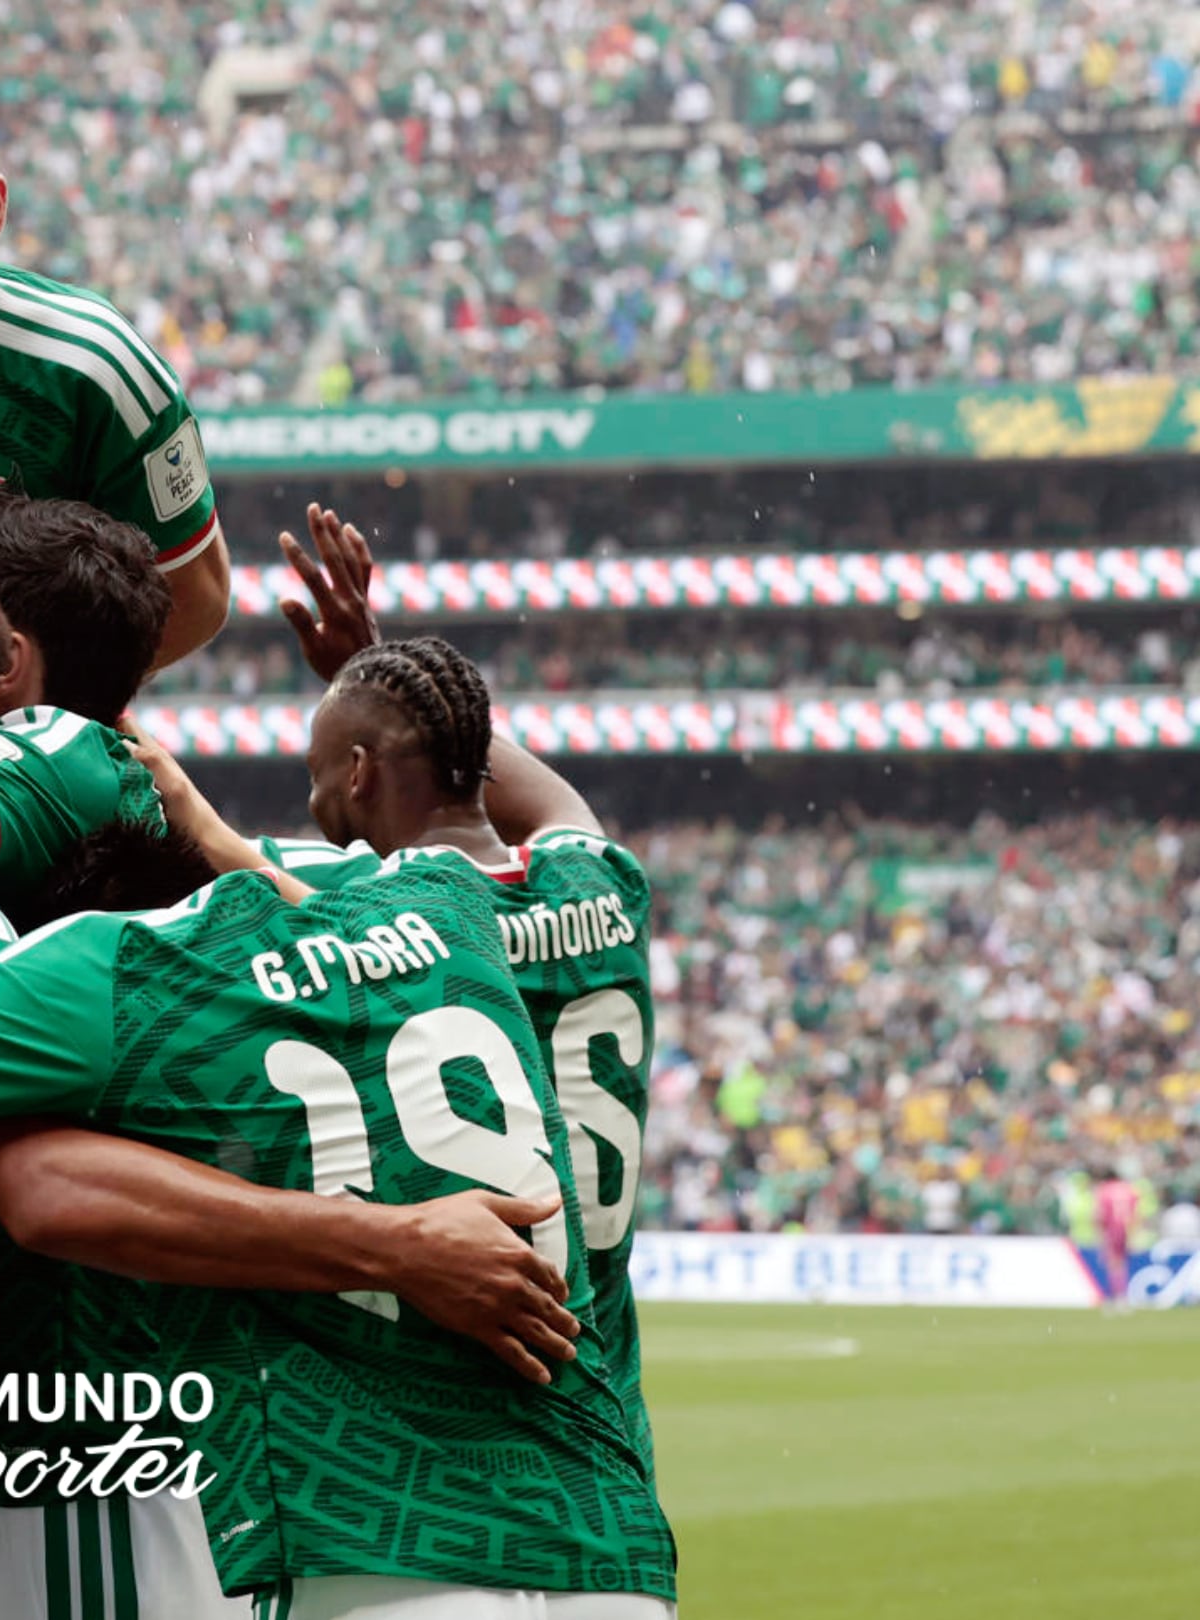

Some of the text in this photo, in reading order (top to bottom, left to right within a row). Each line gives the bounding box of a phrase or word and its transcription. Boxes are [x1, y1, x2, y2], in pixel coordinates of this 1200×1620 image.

[203, 412, 440, 457] MEXICO
[250, 911, 450, 1002] G.MORA
[496, 892, 635, 964] UIÑONES
[551, 988, 643, 1249] 6
[264, 1005, 569, 1322] 19
[793, 1245, 992, 1292] BEER
